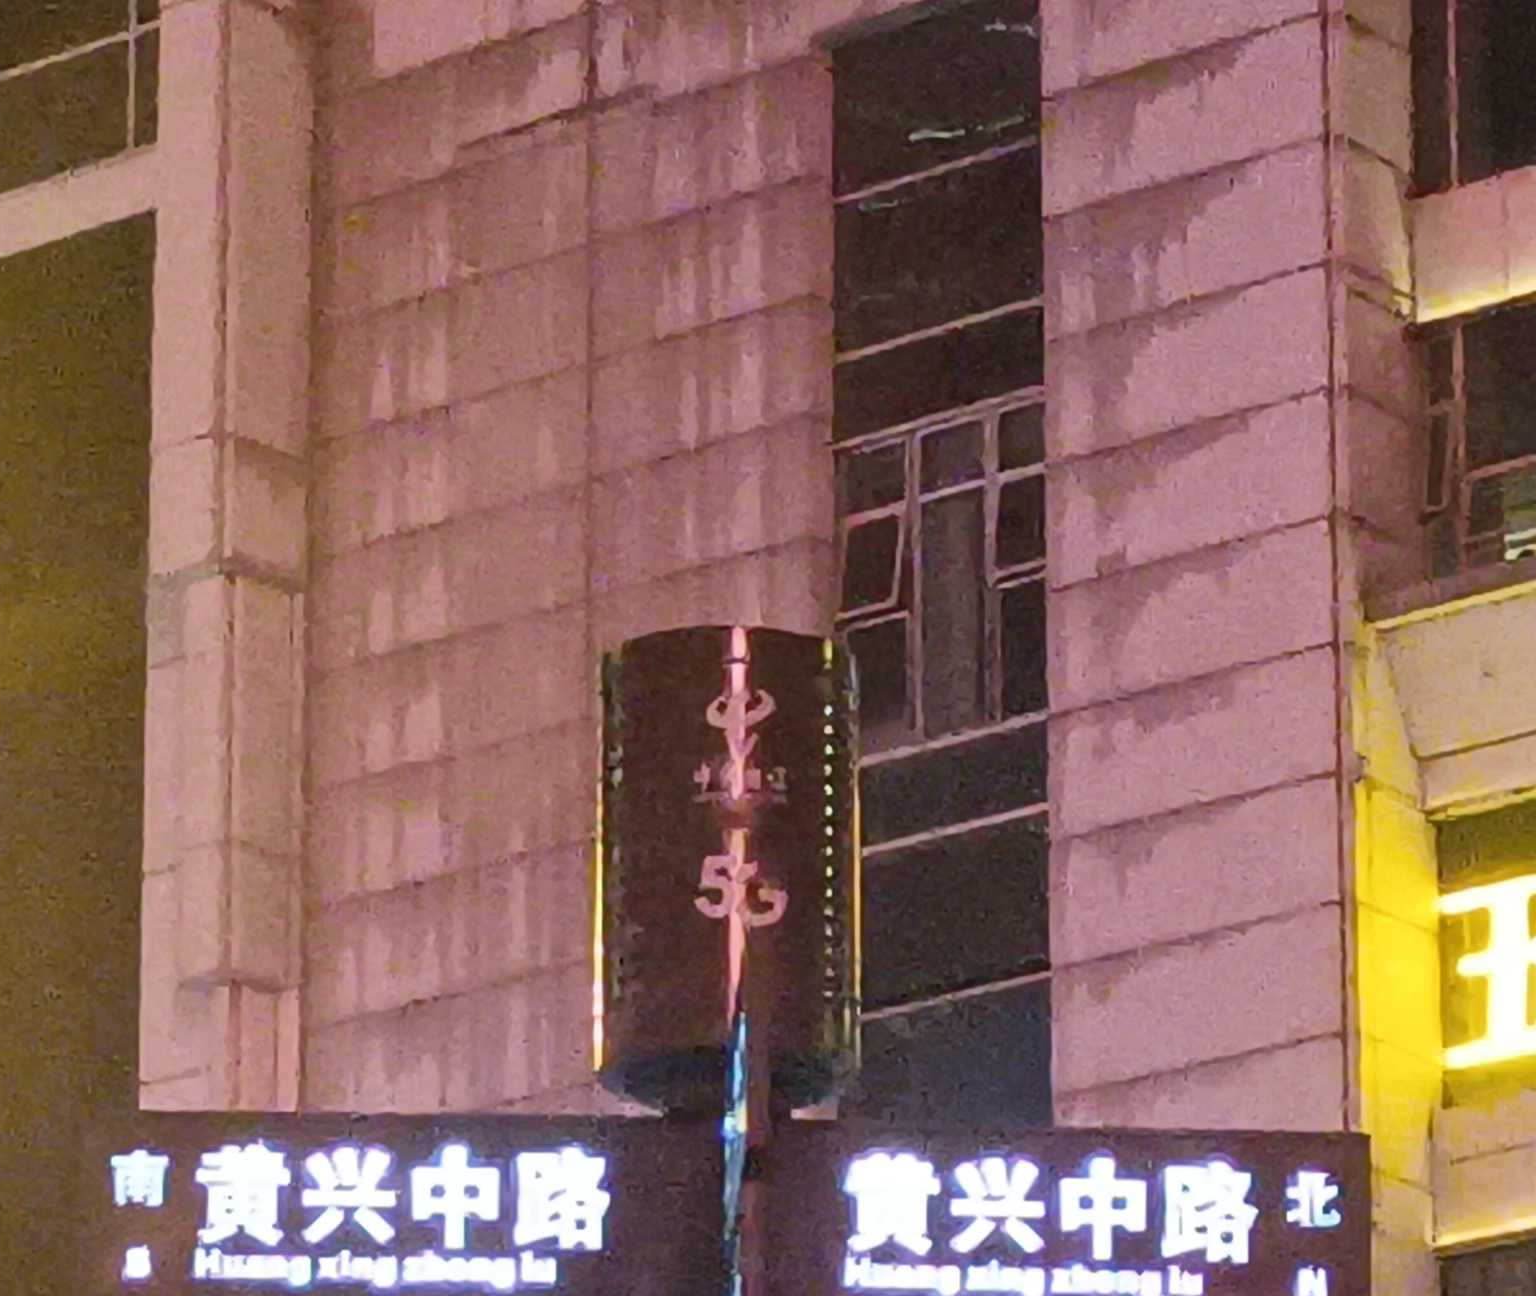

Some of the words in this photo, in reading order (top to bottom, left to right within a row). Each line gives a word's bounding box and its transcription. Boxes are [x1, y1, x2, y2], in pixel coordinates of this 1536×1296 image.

[195, 1141, 611, 1249] 黄兴中路
[844, 1152, 1259, 1264] 黄兴中路
[1286, 1171, 1341, 1227] 北
